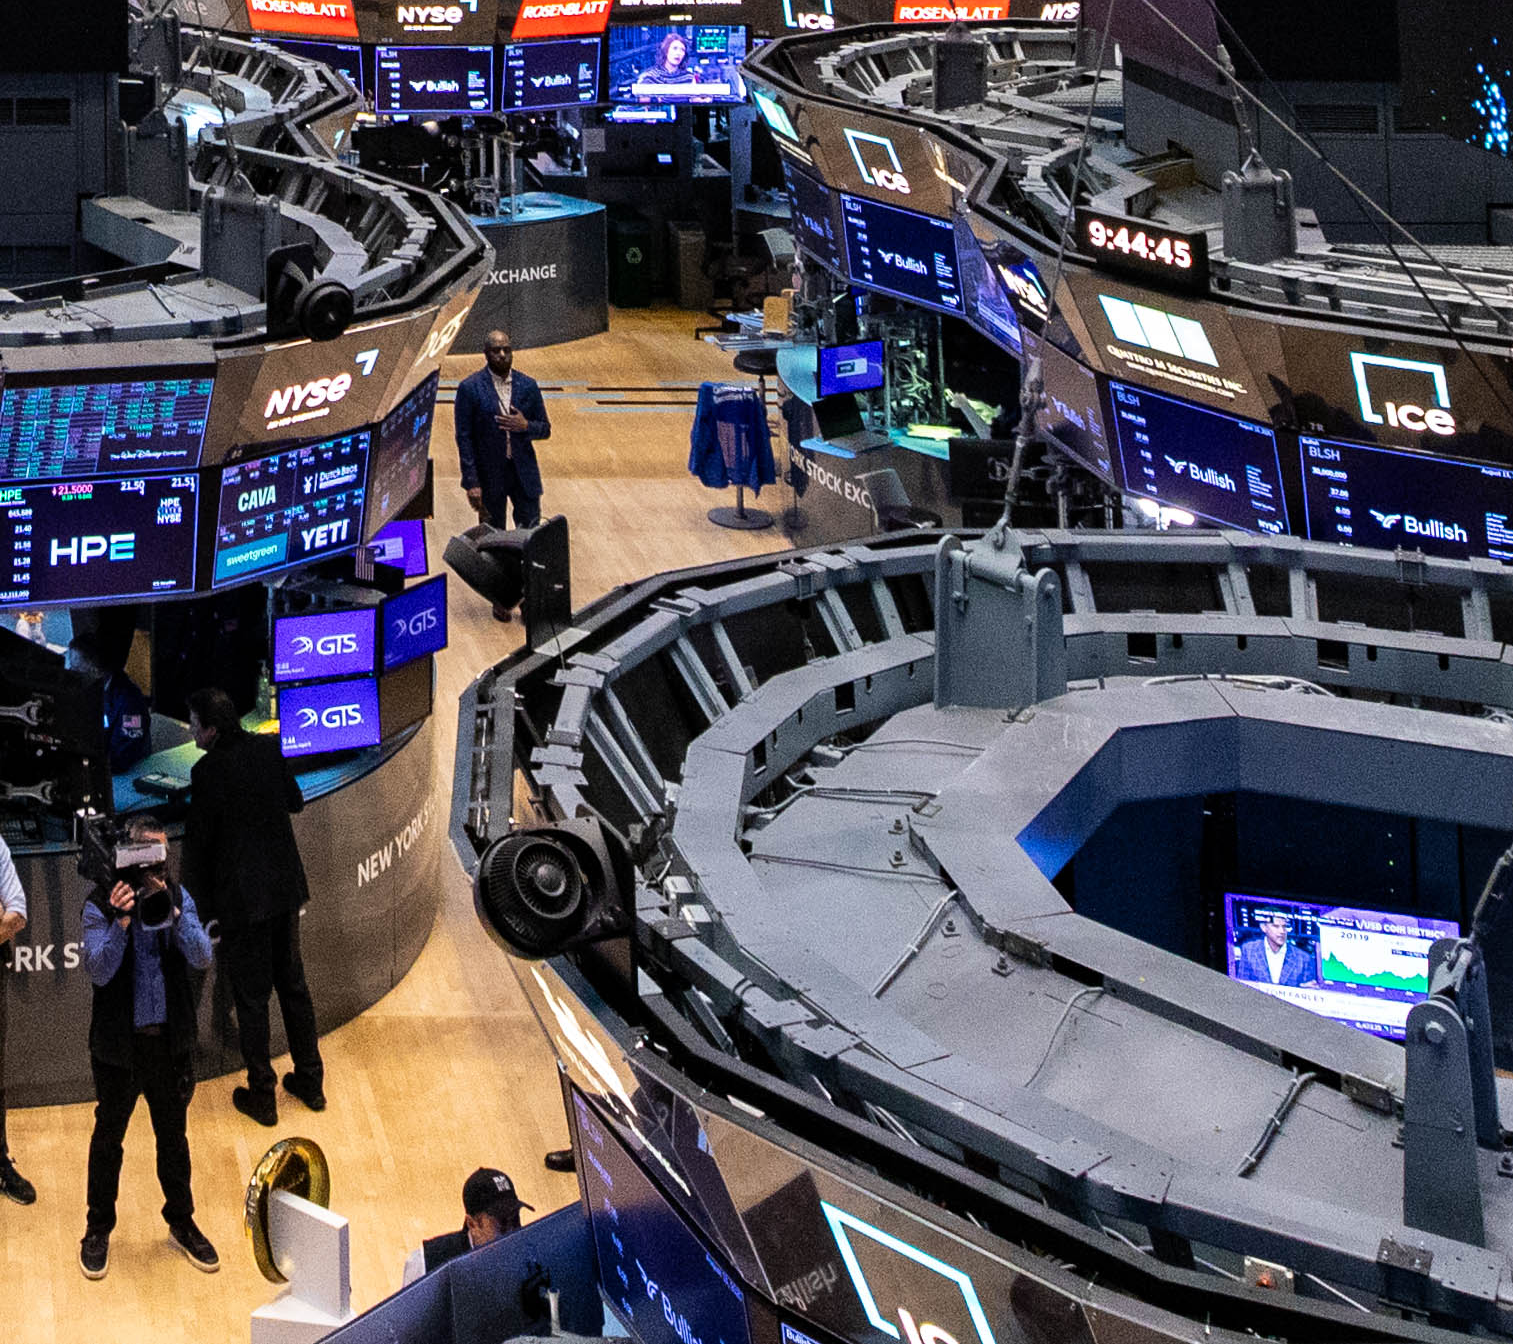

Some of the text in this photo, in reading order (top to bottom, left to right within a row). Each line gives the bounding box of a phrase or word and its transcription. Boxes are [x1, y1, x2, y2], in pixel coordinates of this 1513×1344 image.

[522, 0, 608, 19] ROSENBLATT
[1088, 219, 1193, 270] 9:44:45
[895, 254, 928, 276] Bullish
[1116, 390, 1141, 407] BLSH
[1308, 446, 1341, 462] BLSH
[58, 483, 93, 496] 21.5000
[806, 458, 842, 495] STOCK
[1188, 462, 1237, 493] Bullish
[160, 497, 181, 507] HPE
[237, 485, 276, 513] CAVA
[157, 513, 182, 525] NYSE
[1404, 515, 1468, 543] Bullish
[300, 517, 351, 552] YETI
[50, 532, 135, 567] HPE
[226, 543, 278, 567] sweetgreen
[408, 607, 437, 636] GTS
[356, 848, 392, 888] NEW
